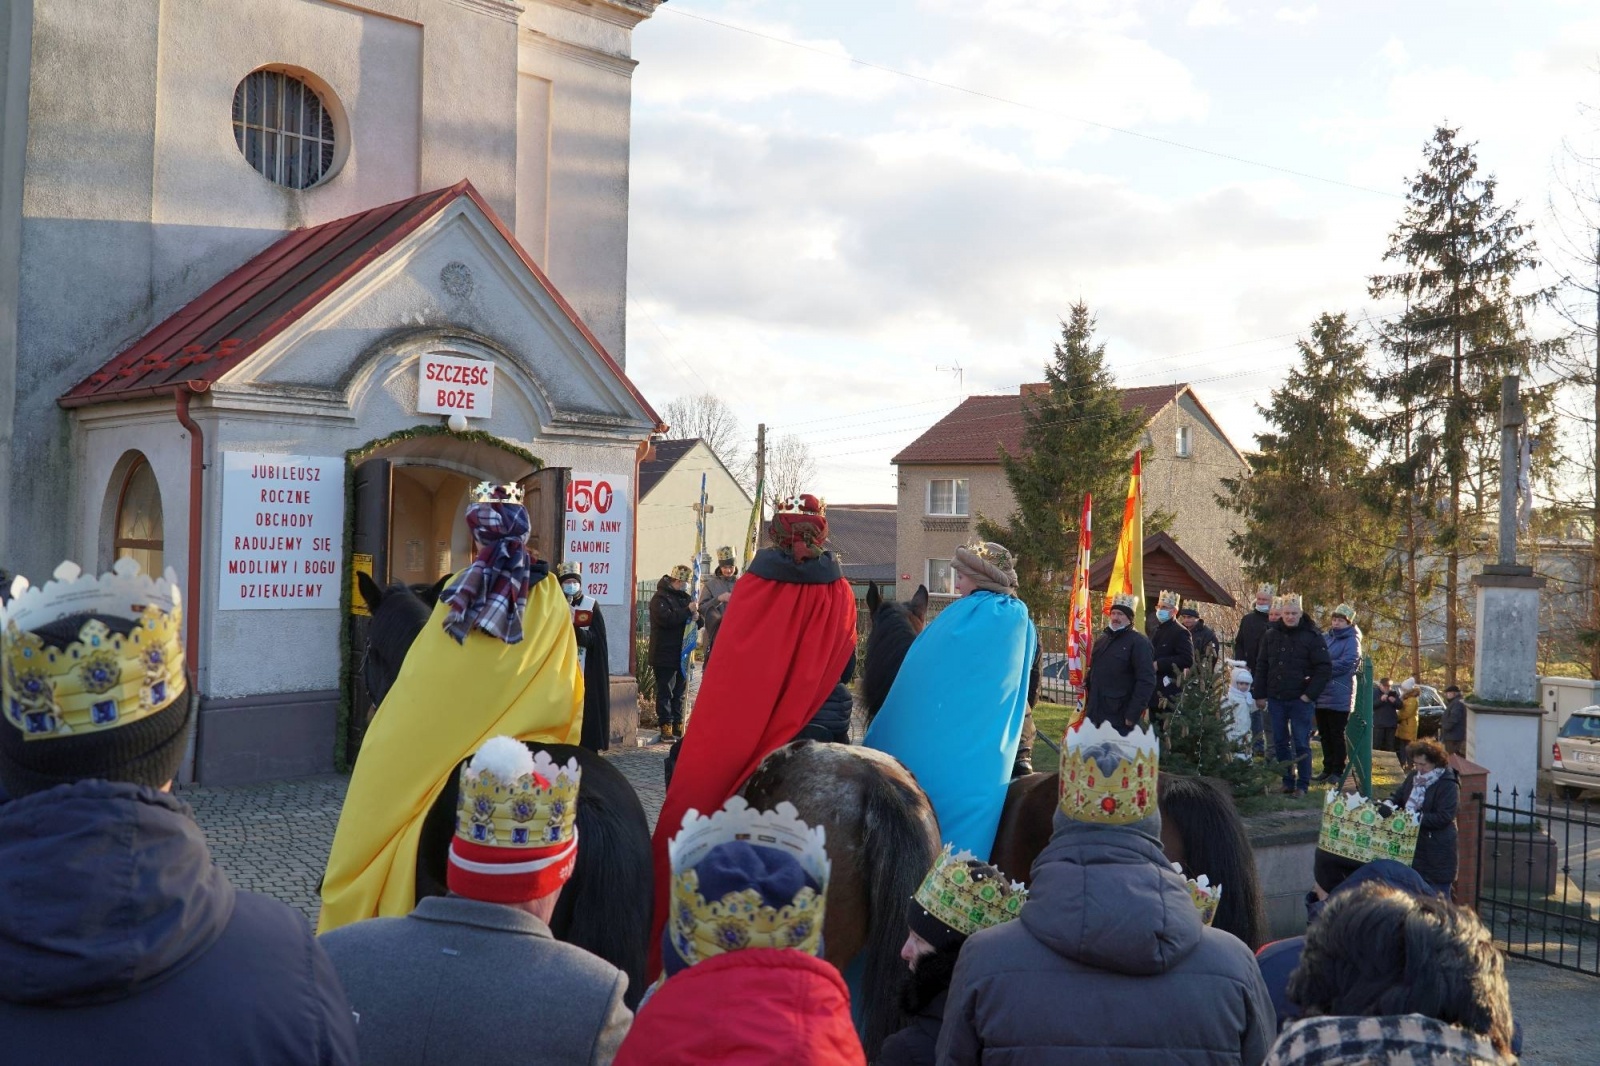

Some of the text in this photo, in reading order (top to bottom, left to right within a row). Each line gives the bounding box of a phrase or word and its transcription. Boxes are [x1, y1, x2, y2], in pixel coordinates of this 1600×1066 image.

[426, 362, 488, 386] SZCZĘŚĆ
[437, 389, 475, 410] BOŻE
[251, 465, 320, 481] JUBILEUSZ
[260, 489, 311, 504] ROCZNE
[565, 480, 613, 514] 150
[256, 512, 313, 527] OBCHODY
[600, 520, 621, 533] ANNY
[234, 536, 331, 552] RADUJEMY SIĘ
[570, 540, 610, 553] GAMOWIE
[228, 560, 336, 574] MODLIMY I BOGU
[589, 562, 609, 574] 1871
[240, 584, 323, 598] DZIĘKUJEMY
[587, 583, 608, 595] 1872
